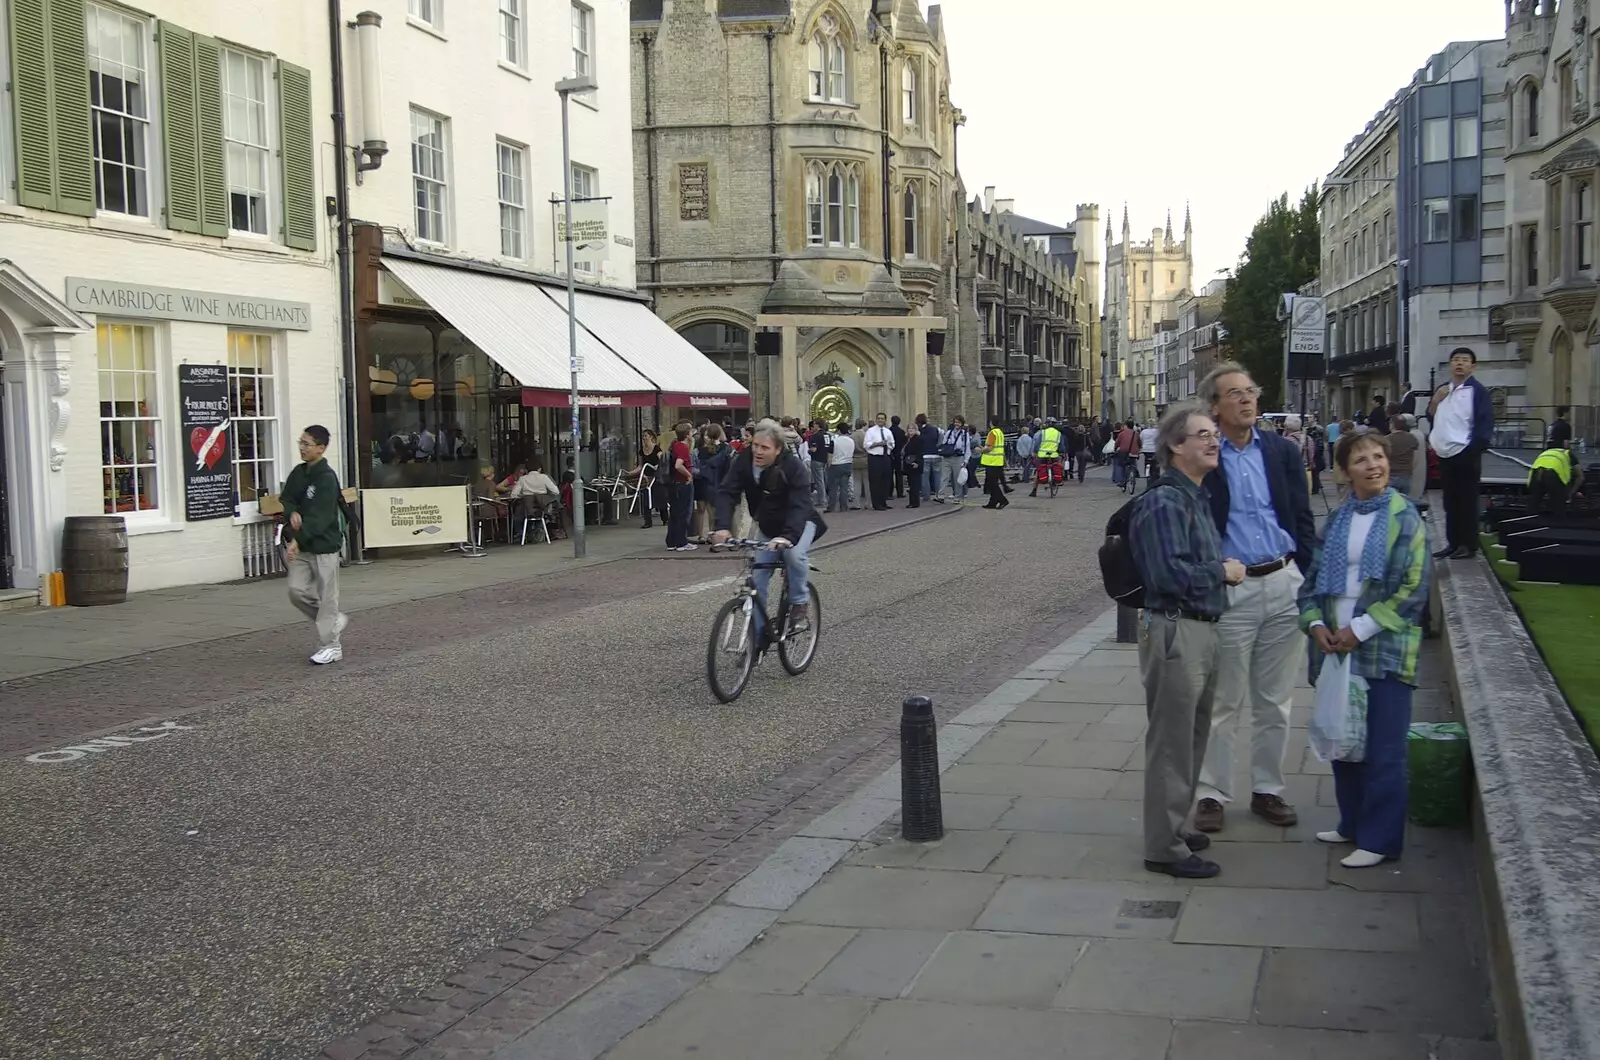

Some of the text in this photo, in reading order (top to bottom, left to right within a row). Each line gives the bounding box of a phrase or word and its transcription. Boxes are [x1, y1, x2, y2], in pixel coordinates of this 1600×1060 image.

[75, 285, 308, 324] CAMBRIDGE WINE MERCHANTS
[1294, 343, 1320, 351] ENDS
[390, 497, 404, 505] The
[391, 505, 440, 515] Cambridge
[415, 515, 442, 525] House
